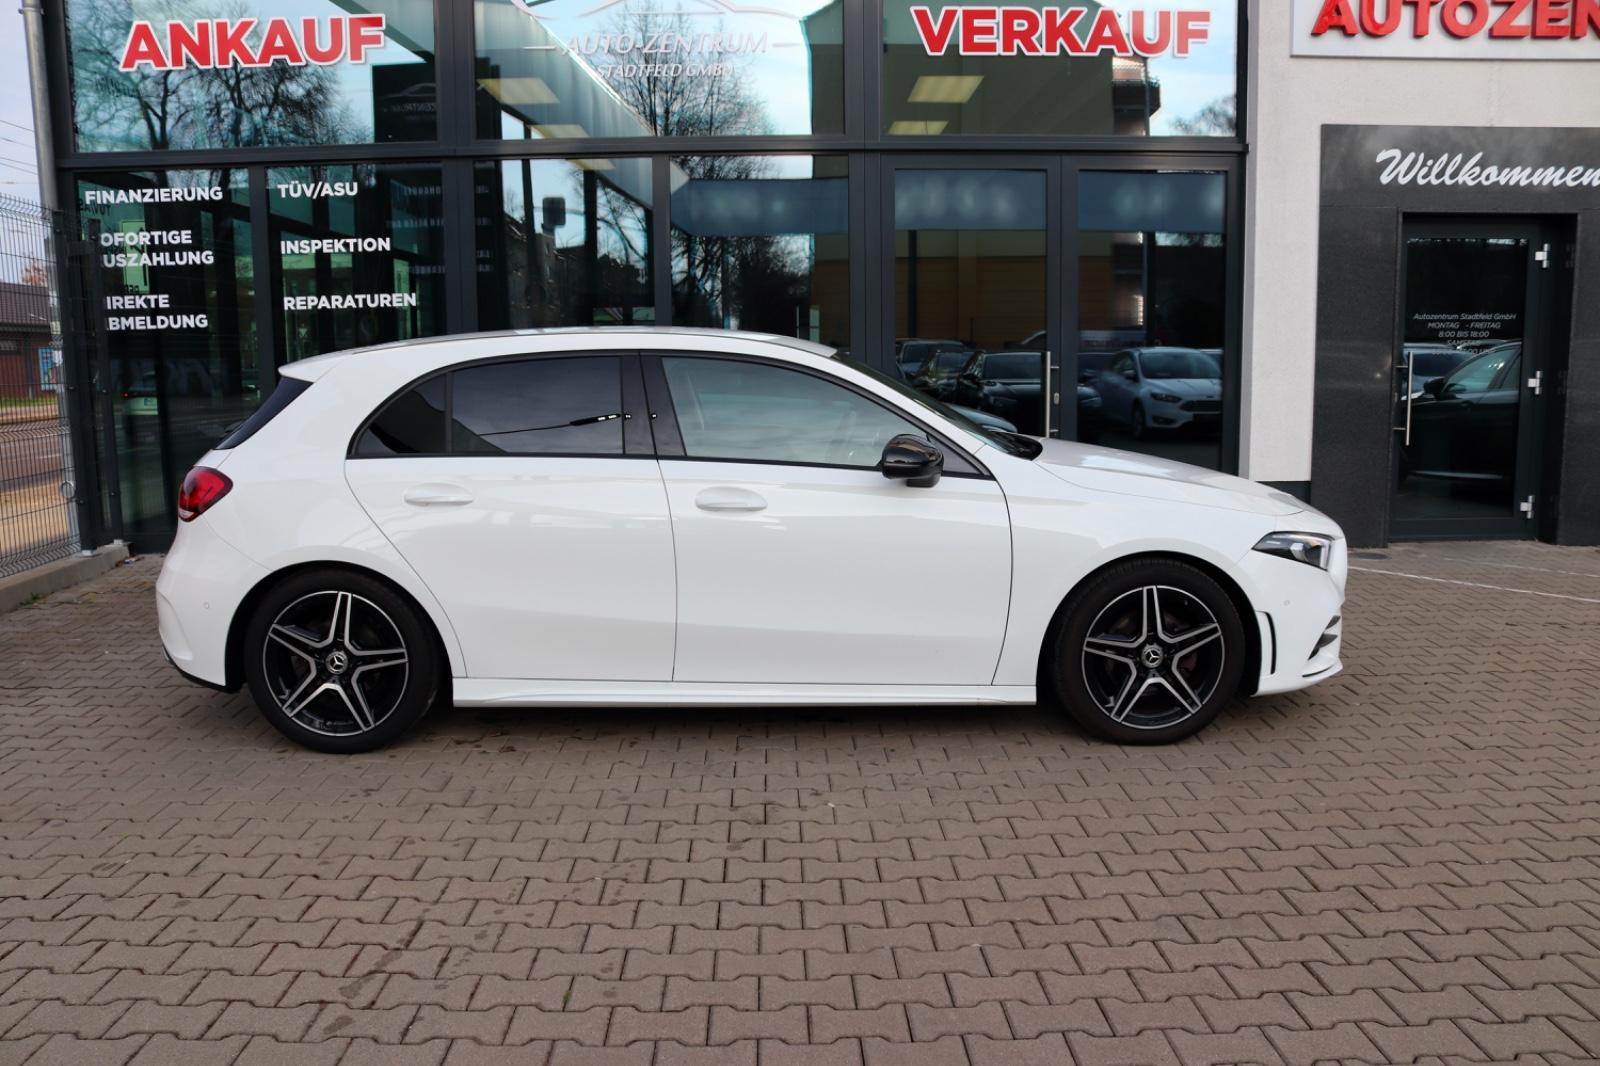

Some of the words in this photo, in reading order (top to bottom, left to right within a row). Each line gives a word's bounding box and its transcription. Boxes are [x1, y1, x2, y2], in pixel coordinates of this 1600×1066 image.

[909, 6, 1212, 58] VERKAUF
[119, 14, 386, 71] ANKAUF
[1375, 148, 1600, 188] Willkommen
[84, 186, 223, 205] FINANZIERUNG
[277, 181, 359, 199] TÜV/ASU
[100, 230, 193, 247] OFORTIGE
[280, 237, 391, 255] INSPEKTION
[103, 251, 215, 268] USZAHLUNG
[106, 294, 170, 310] IREKTE
[283, 292, 417, 311] REPARATUREN
[106, 314, 209, 331] BMELDUNG
